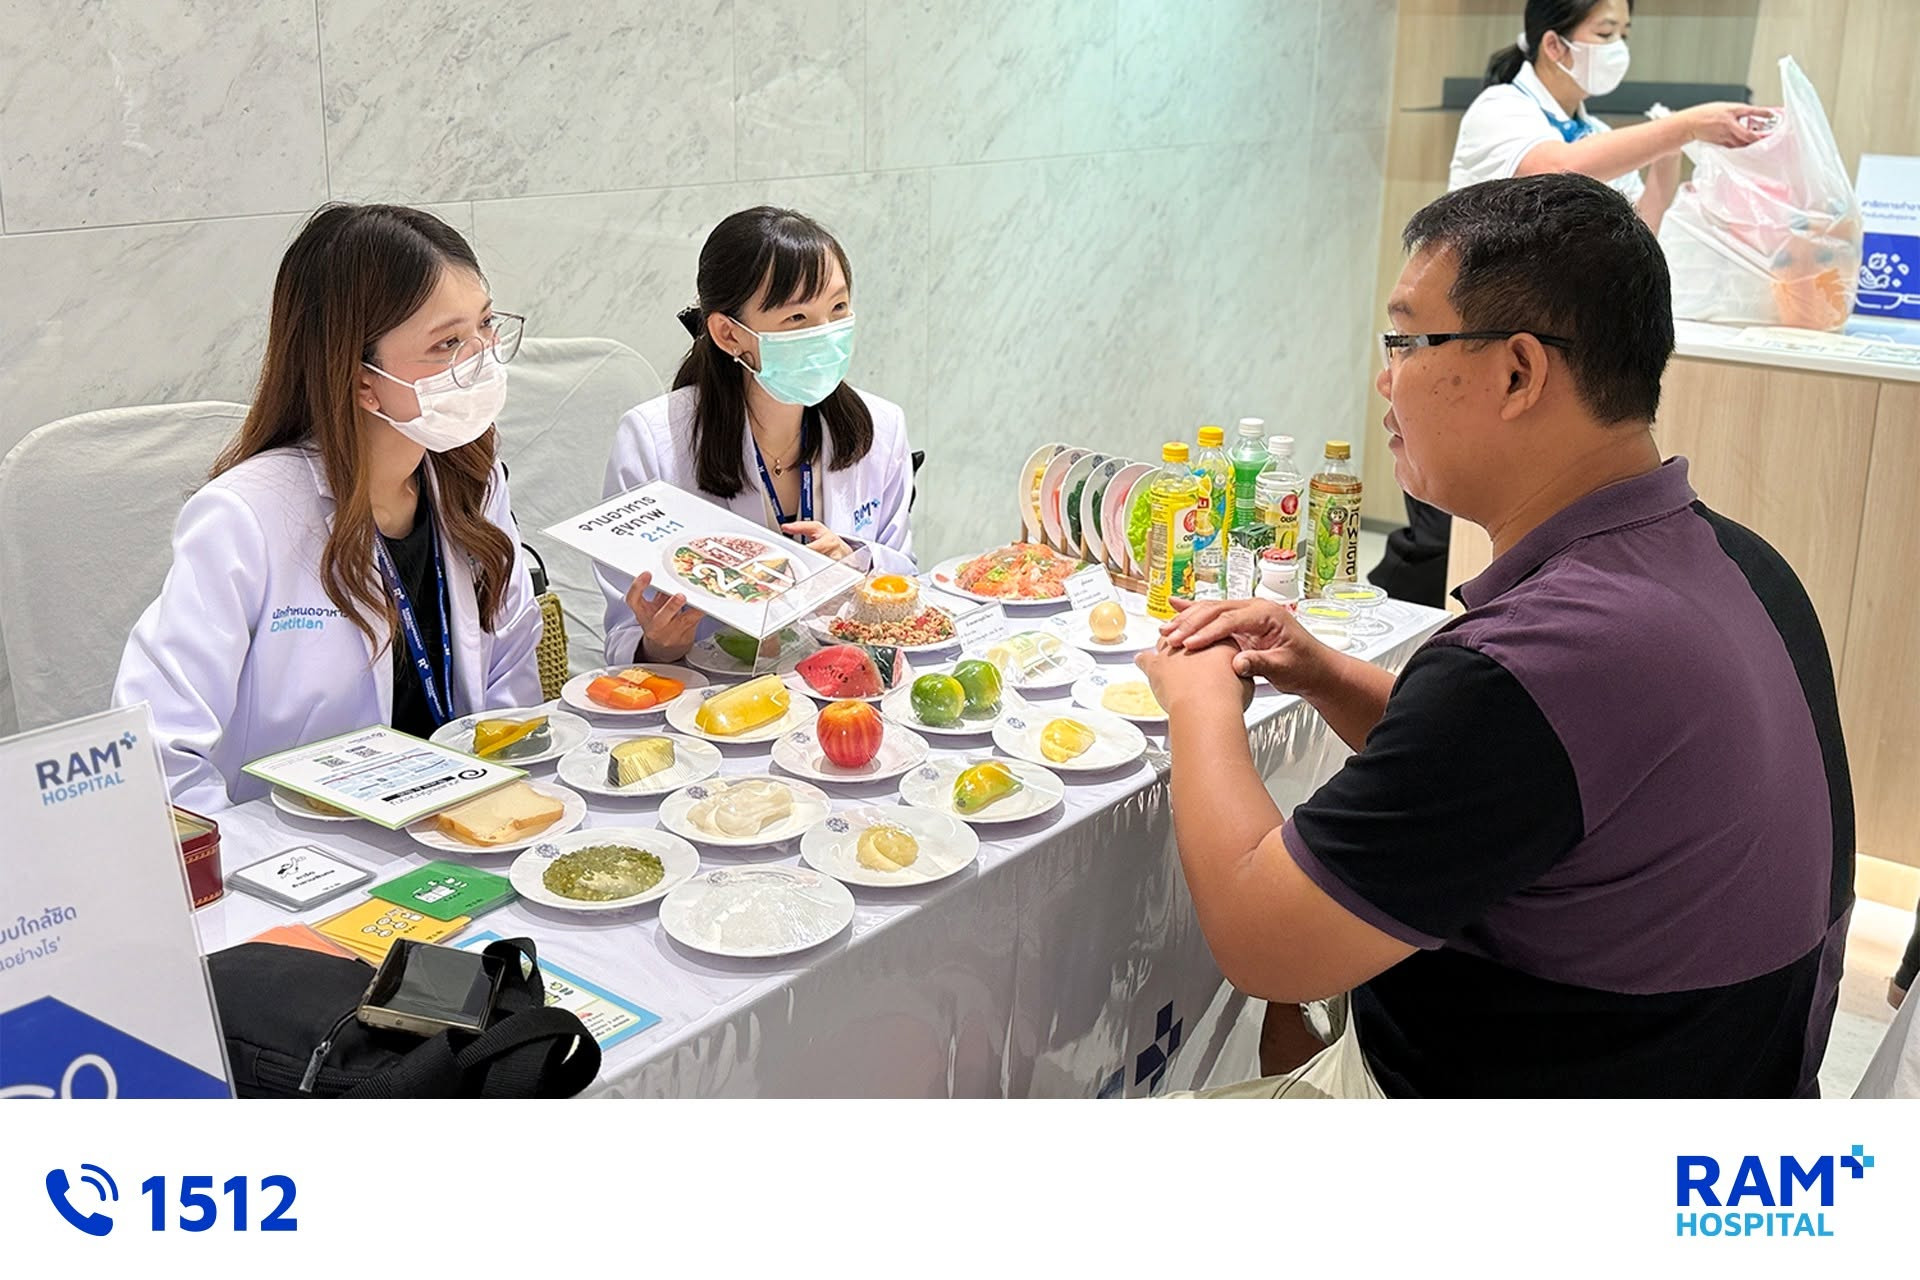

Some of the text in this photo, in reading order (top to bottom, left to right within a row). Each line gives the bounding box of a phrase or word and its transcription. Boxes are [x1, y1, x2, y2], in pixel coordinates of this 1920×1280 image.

[578, 496, 657, 532] จานอาหาร
[611, 508, 666, 536] สุขภาพ
[640, 520, 685, 543] 2:1:1
[270, 617, 324, 633] Dietitian
[35, 740, 122, 790] RAM
[41, 771, 125, 807] HOSPITAL
